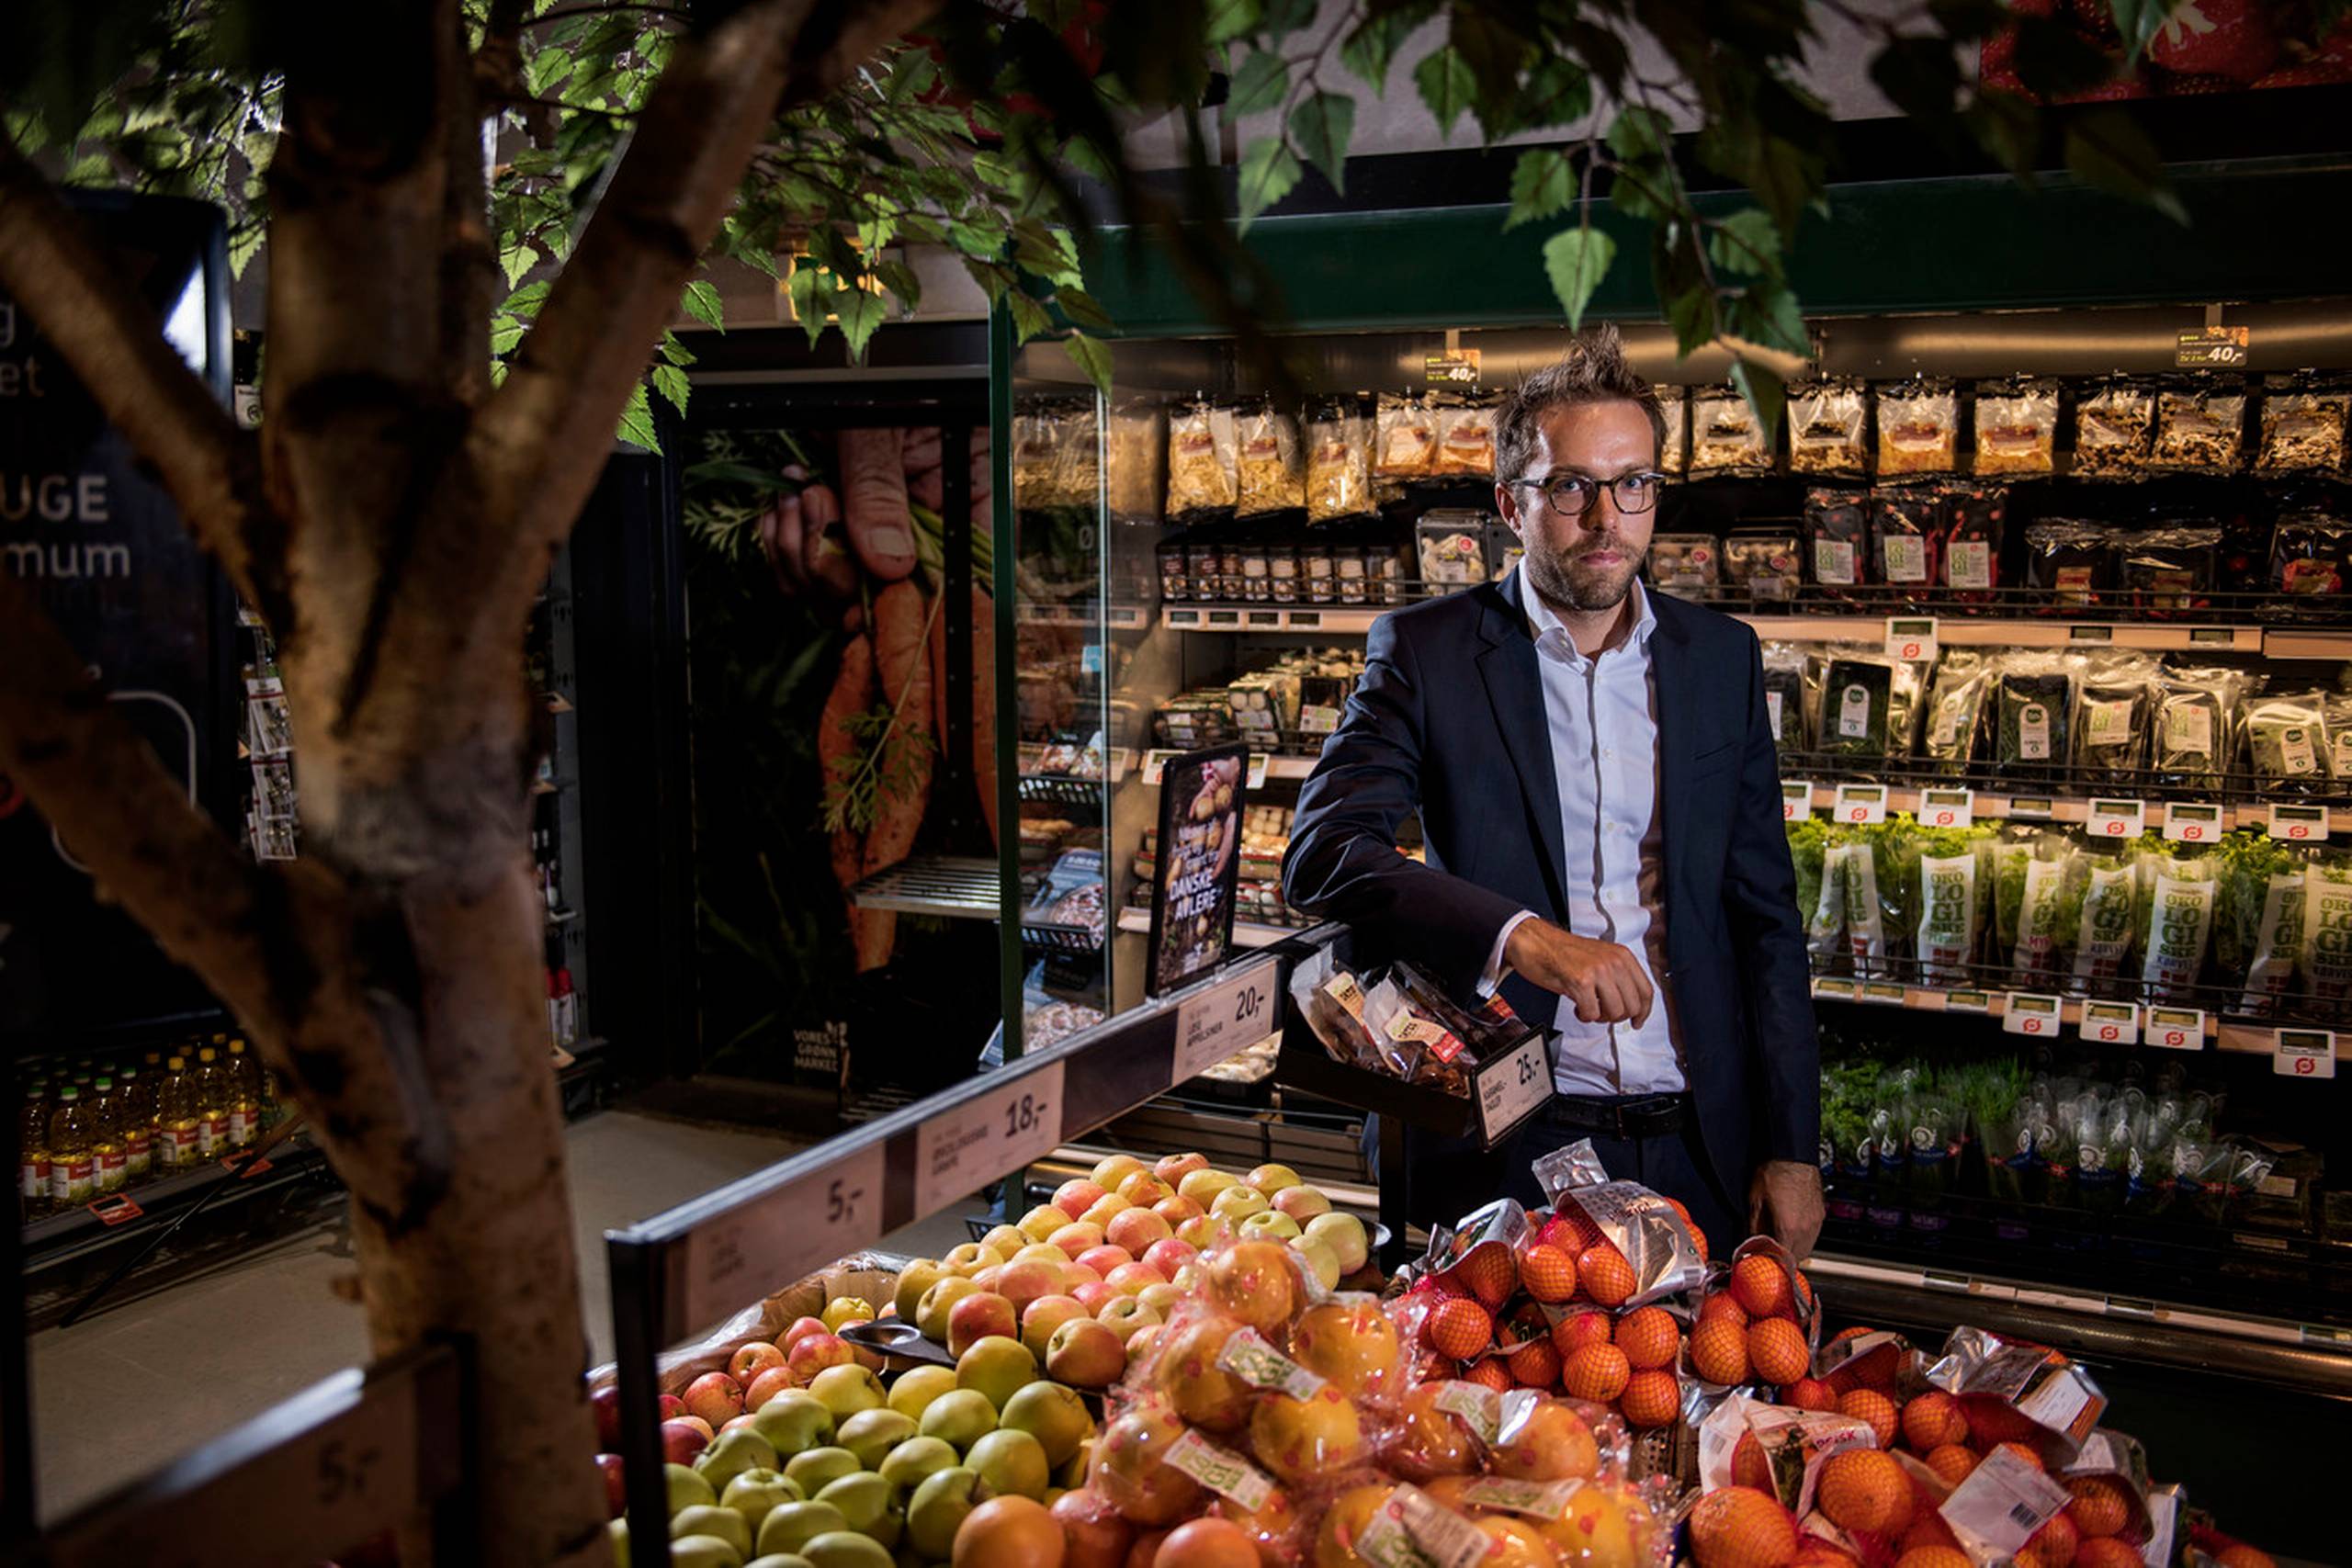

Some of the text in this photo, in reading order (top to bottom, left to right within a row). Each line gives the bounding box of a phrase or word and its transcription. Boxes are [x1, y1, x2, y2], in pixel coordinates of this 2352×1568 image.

[1169, 866, 1214, 902] DANSKE
[1931, 883, 1964, 901] LO
[1931, 900, 1965, 922] GI
[2164, 905, 2201, 926] LO
[2162, 923, 2199, 946] GI
[1235, 985, 1265, 1021] 20,-
[1004, 1094, 1047, 1138] 18,-
[826, 1178, 865, 1224] 5,-
